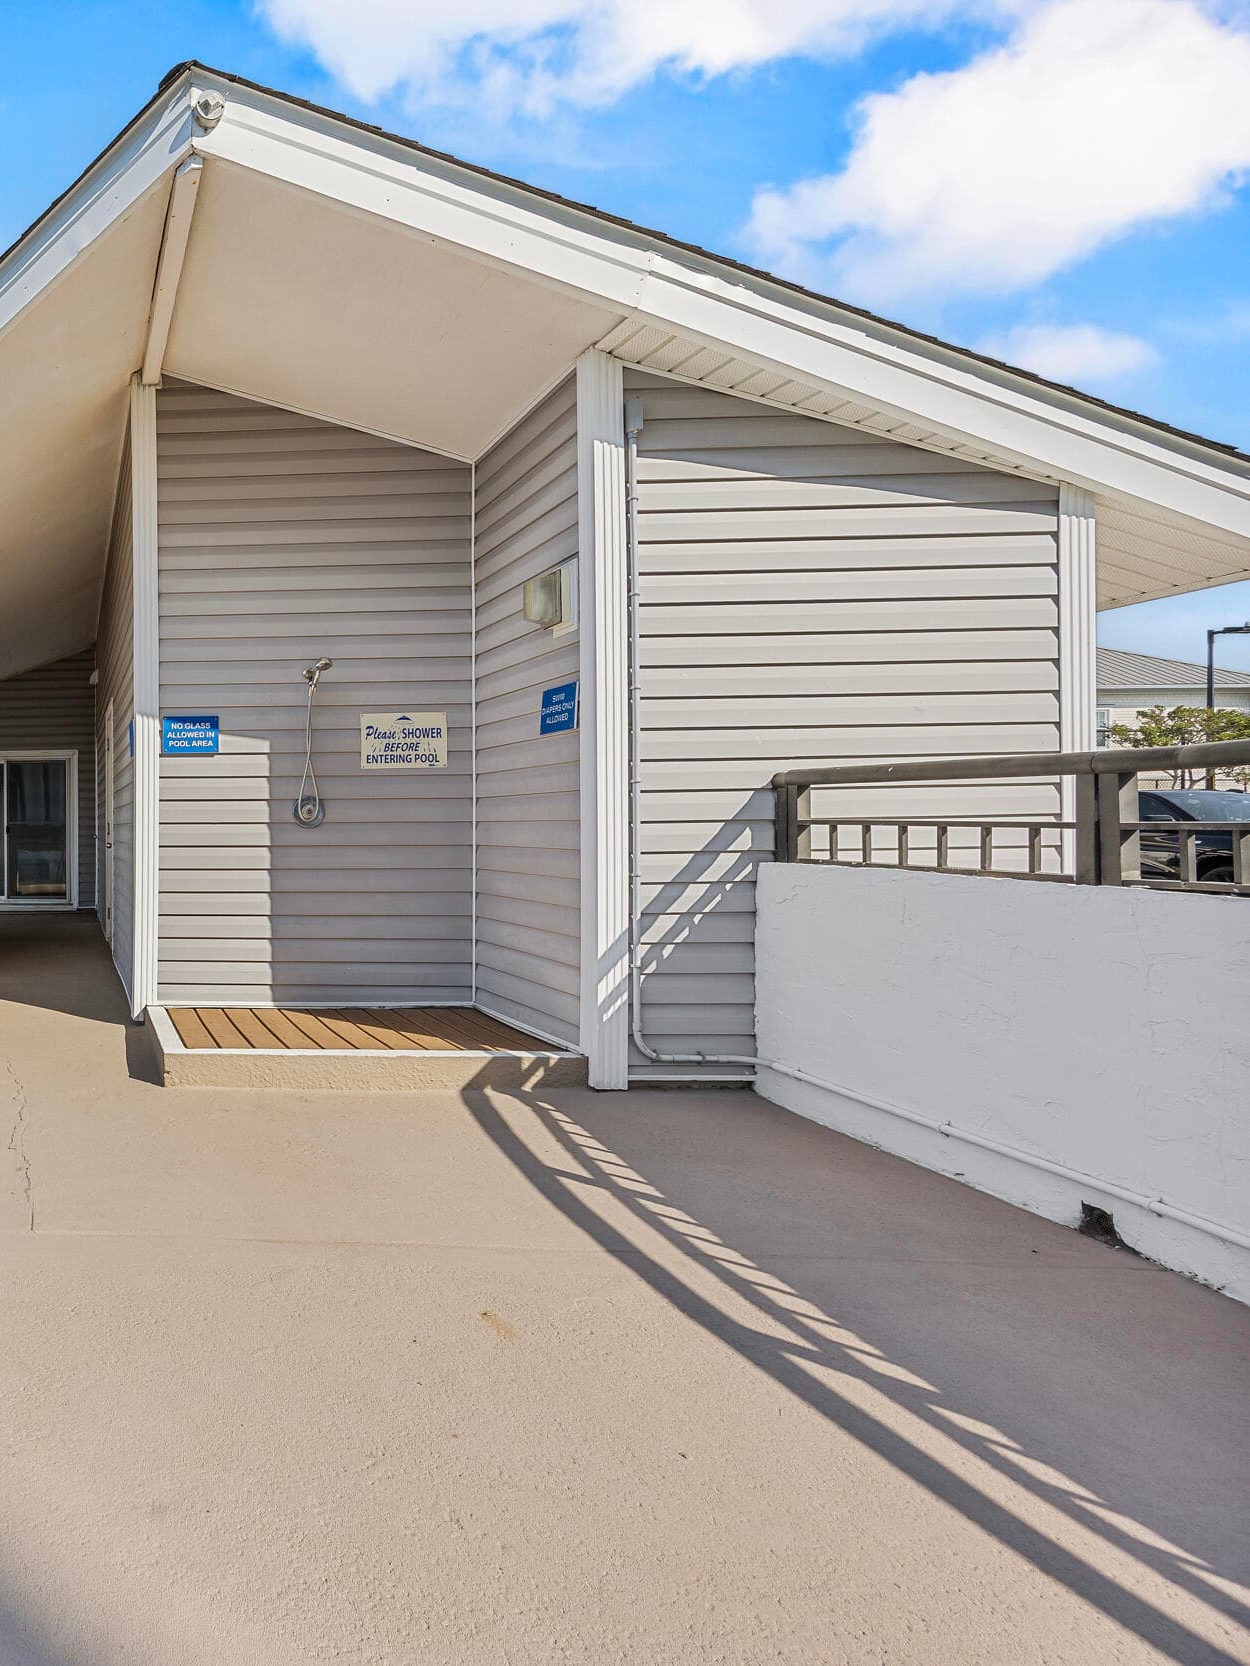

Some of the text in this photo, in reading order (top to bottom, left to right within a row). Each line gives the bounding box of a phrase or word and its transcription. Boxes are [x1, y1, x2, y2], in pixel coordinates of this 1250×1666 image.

[542, 701, 575, 715] DIAPERS ONLY
[546, 712, 569, 724] ALLOWED
[171, 722, 183, 730] NO
[365, 725, 442, 740] Please SHOWER
[383, 742, 421, 752] BEFORE
[366, 753, 440, 764] ENTERING POOL
